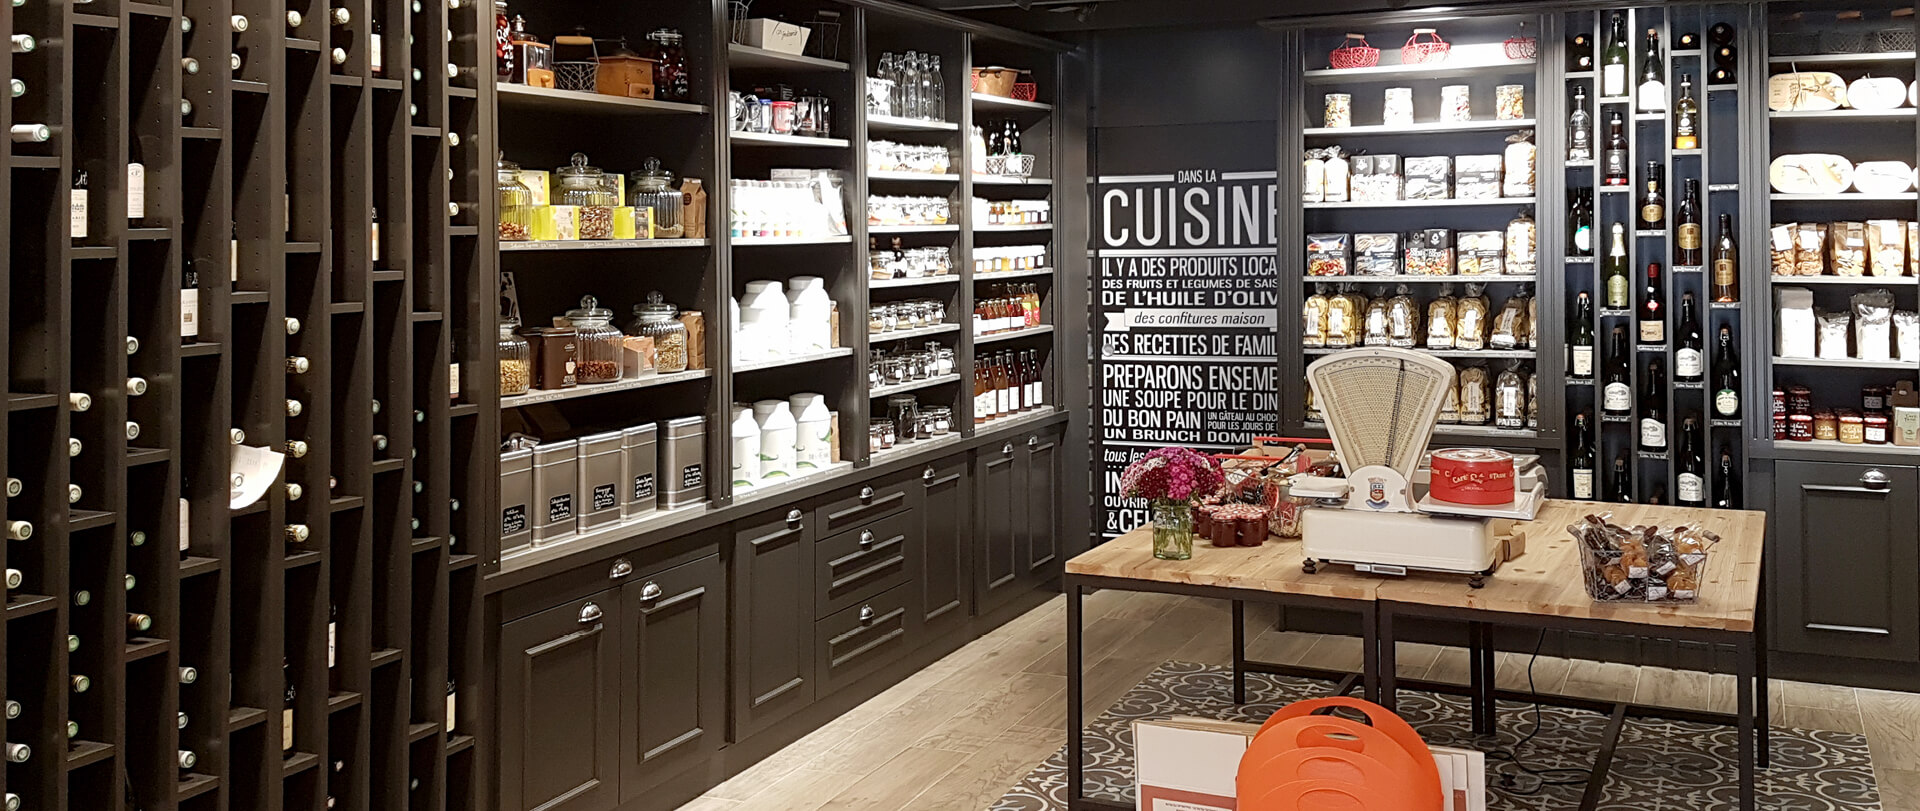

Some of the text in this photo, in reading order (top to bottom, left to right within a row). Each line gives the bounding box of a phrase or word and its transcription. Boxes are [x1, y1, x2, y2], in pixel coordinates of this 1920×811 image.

[1178, 170, 1216, 183] DANS LA
[1102, 256, 1277, 277] IL Y A DES PRODUITS LOCA
[1102, 279, 1123, 289] DES
[1126, 279, 1162, 289] FRUITS
[1166, 279, 1179, 288] ET
[1182, 279, 1232, 288] LEGUMES
[1236, 279, 1250, 288] DE
[1102, 291, 1126, 306] DE
[1134, 312, 1265, 324] des confitures maison
[1103, 334, 1130, 354] DES
[1134, 334, 1207, 355] RECETTES
[1212, 334, 1230, 355] DE
[1103, 364, 1202, 390] PREPARONS
[1103, 390, 1277, 410] UNE SOUPE POUR LE DIN
[1103, 409, 1201, 429] DU BON PAIN
[1208, 412, 1217, 420] UN
[1246, 413, 1254, 421] AU
[1208, 421, 1226, 430] POUR
[1228, 422, 1240, 430] LES
[1241, 422, 1263, 431] JOURS
[1104, 429, 1126, 439] UN
[1132, 430, 1200, 442] BRUNCH
[1104, 448, 1127, 462] tous
